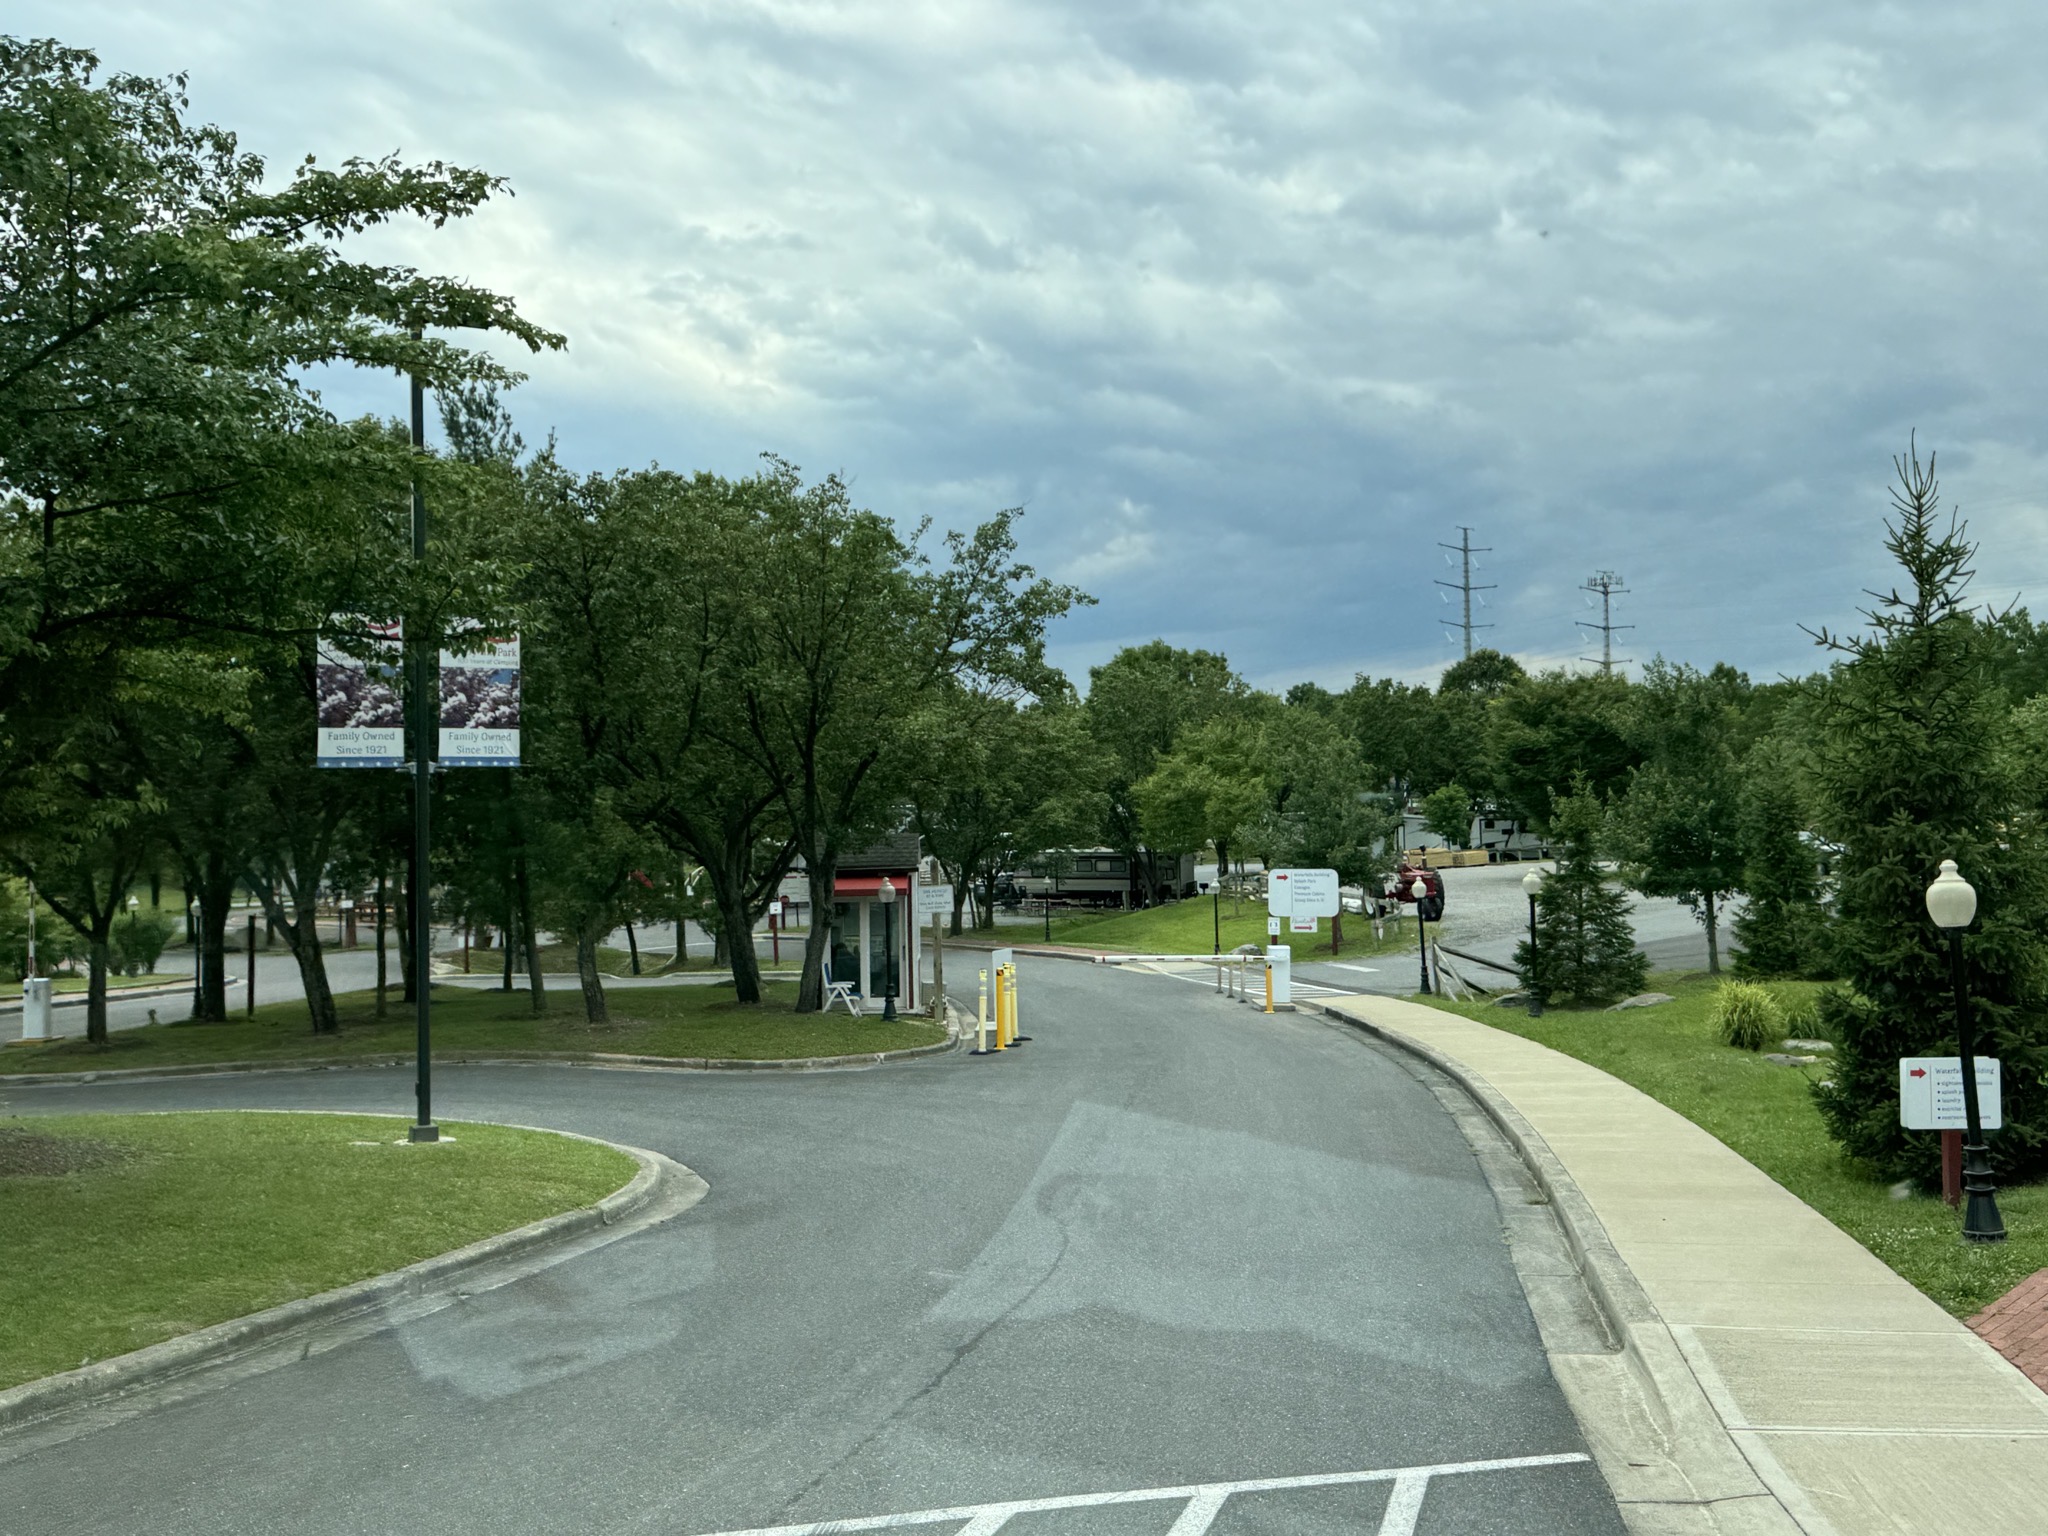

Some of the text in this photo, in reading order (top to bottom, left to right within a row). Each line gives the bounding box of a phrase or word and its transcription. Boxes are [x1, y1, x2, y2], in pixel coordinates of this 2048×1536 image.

[497, 647, 517, 657] Park
[328, 731, 395, 742] Family Owned
[448, 731, 512, 742] Family Owned
[336, 745, 387, 755] Since 1921
[456, 745, 504, 755] Since 1921
